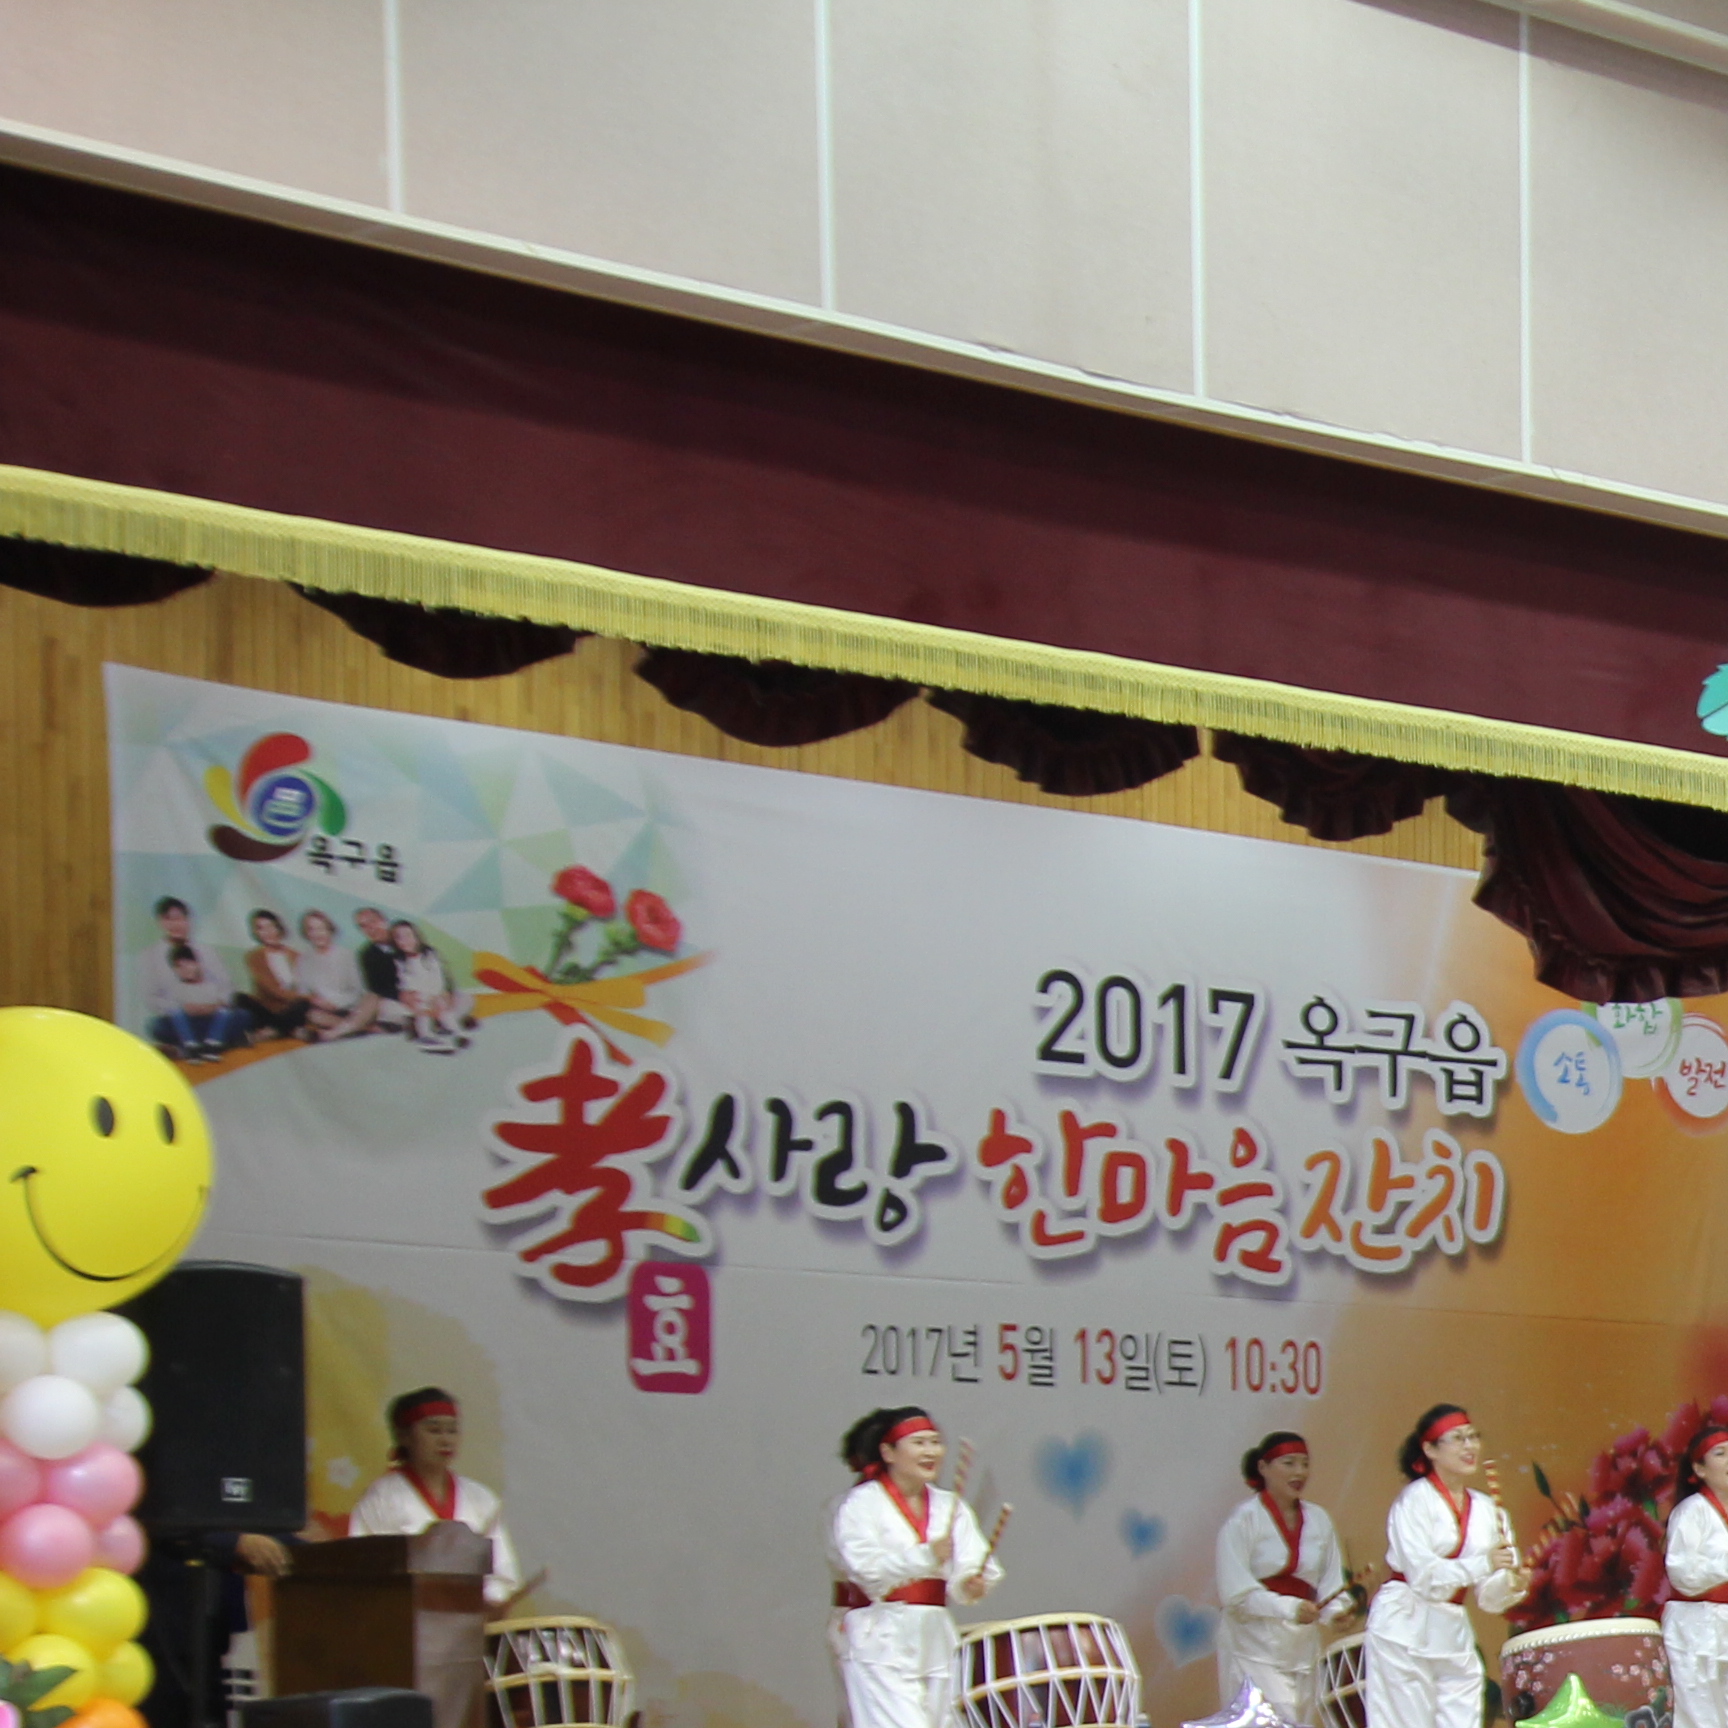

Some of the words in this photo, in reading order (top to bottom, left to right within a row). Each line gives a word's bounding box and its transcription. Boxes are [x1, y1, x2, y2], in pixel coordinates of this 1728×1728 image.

[306, 834, 402, 883] 옥구읍
[1034, 968, 1256, 1084] 2017
[1282, 994, 1504, 1106] 옥구읍
[1611, 1002, 1663, 1036] 화합
[1553, 1051, 1591, 1096] 소통
[1679, 1056, 1727, 1097] 발전
[630, 1277, 702, 1377] 효
[861, 1323, 983, 1385] 2017년
[996, 1321, 1057, 1388] 5월
[1073, 1328, 1209, 1397] 13일(토)
[1225, 1336, 1323, 1397] 10:30
